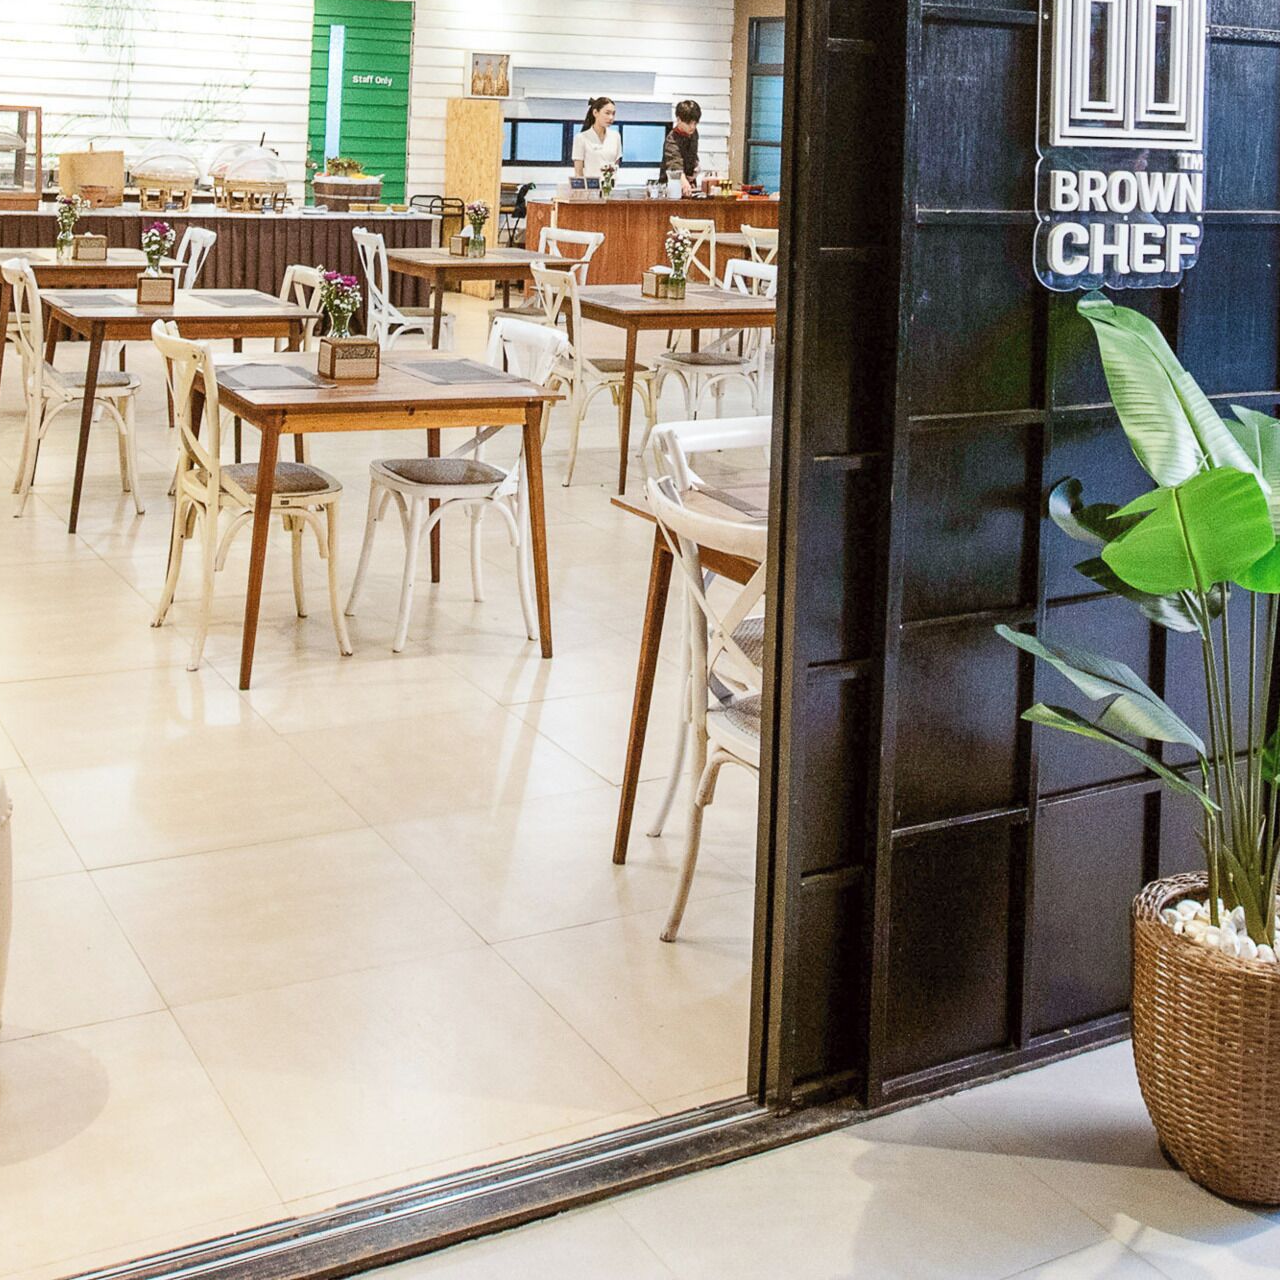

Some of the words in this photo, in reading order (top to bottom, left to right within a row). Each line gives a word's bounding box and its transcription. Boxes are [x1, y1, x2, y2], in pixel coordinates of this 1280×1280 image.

[352, 75, 373, 84] Staff
[375, 76, 392, 87] Only
[1050, 170, 1203, 213] BROWN
[1047, 222, 1200, 276] CHEF
